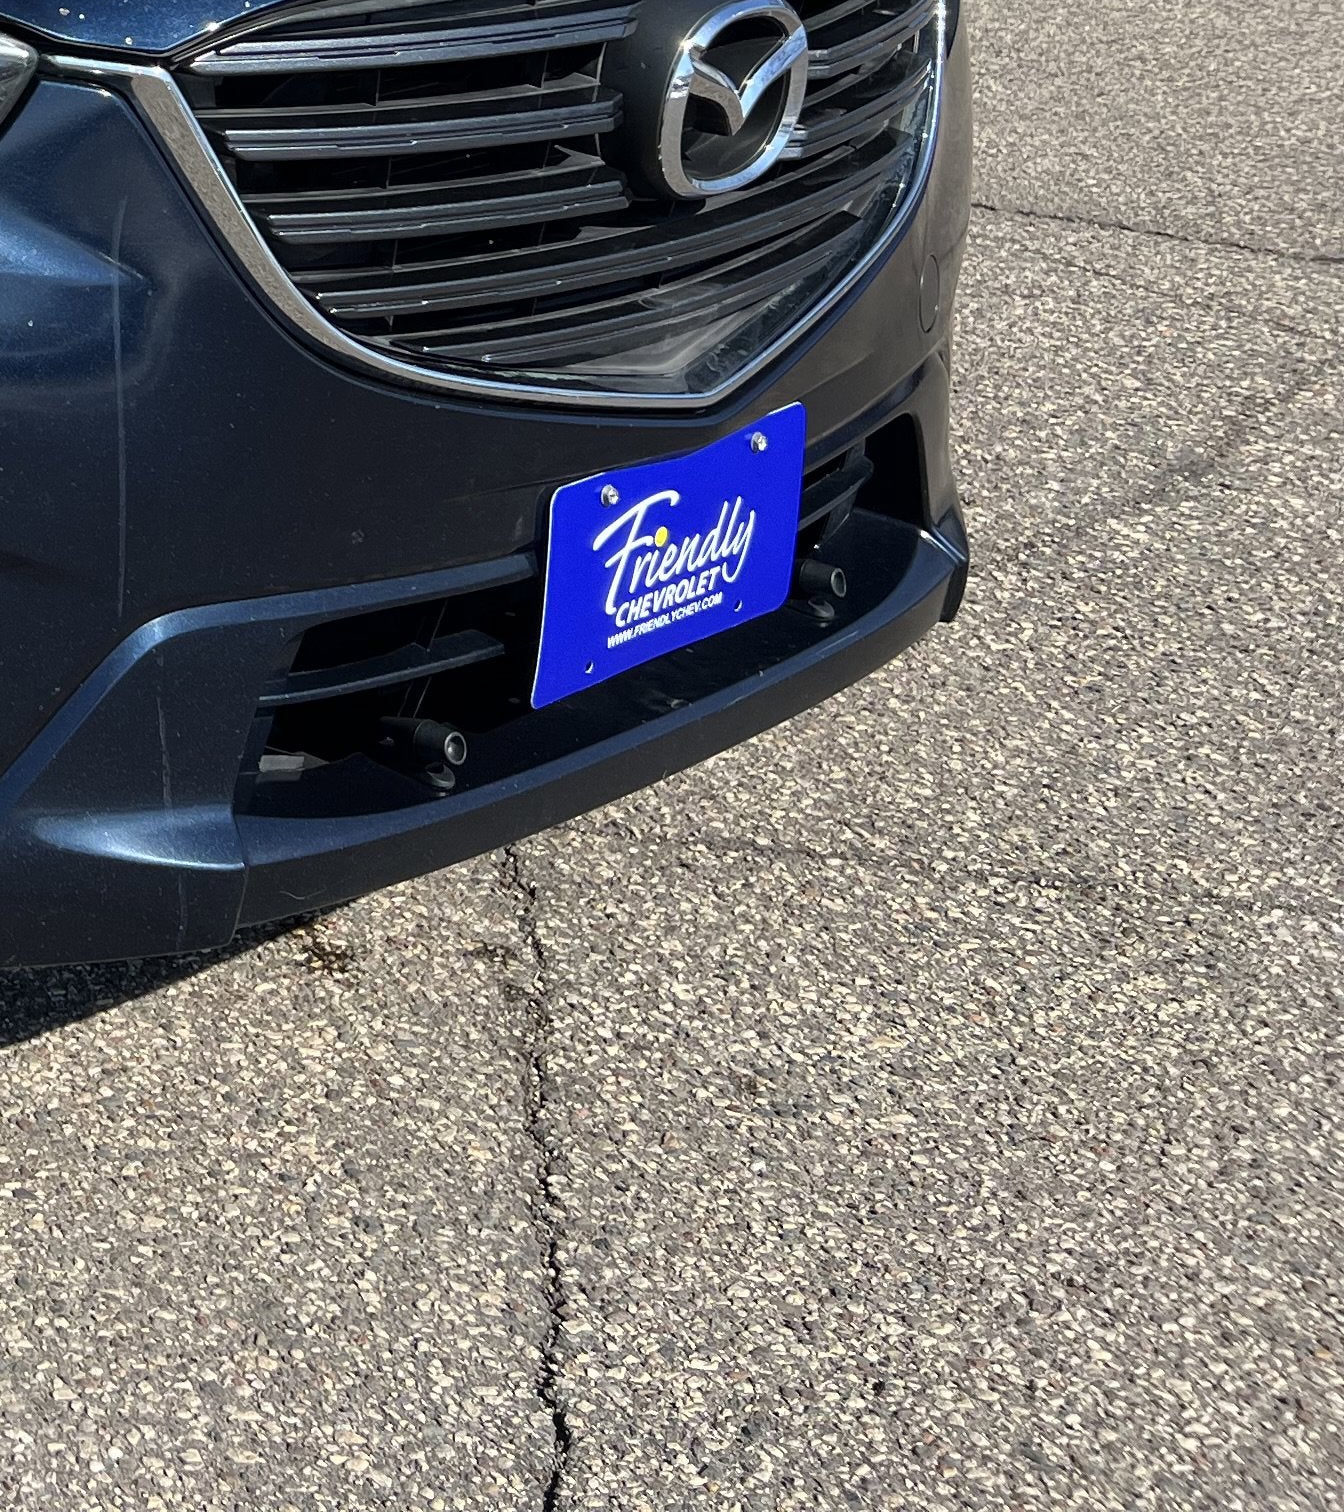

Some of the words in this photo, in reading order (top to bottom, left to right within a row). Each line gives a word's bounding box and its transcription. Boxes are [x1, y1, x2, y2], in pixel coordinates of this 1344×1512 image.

[592, 489, 755, 615] Friendly
[607, 591, 723, 649] WWW.FRIENDLYCHEV.COM
[615, 565, 720, 628] CHEVROLET
